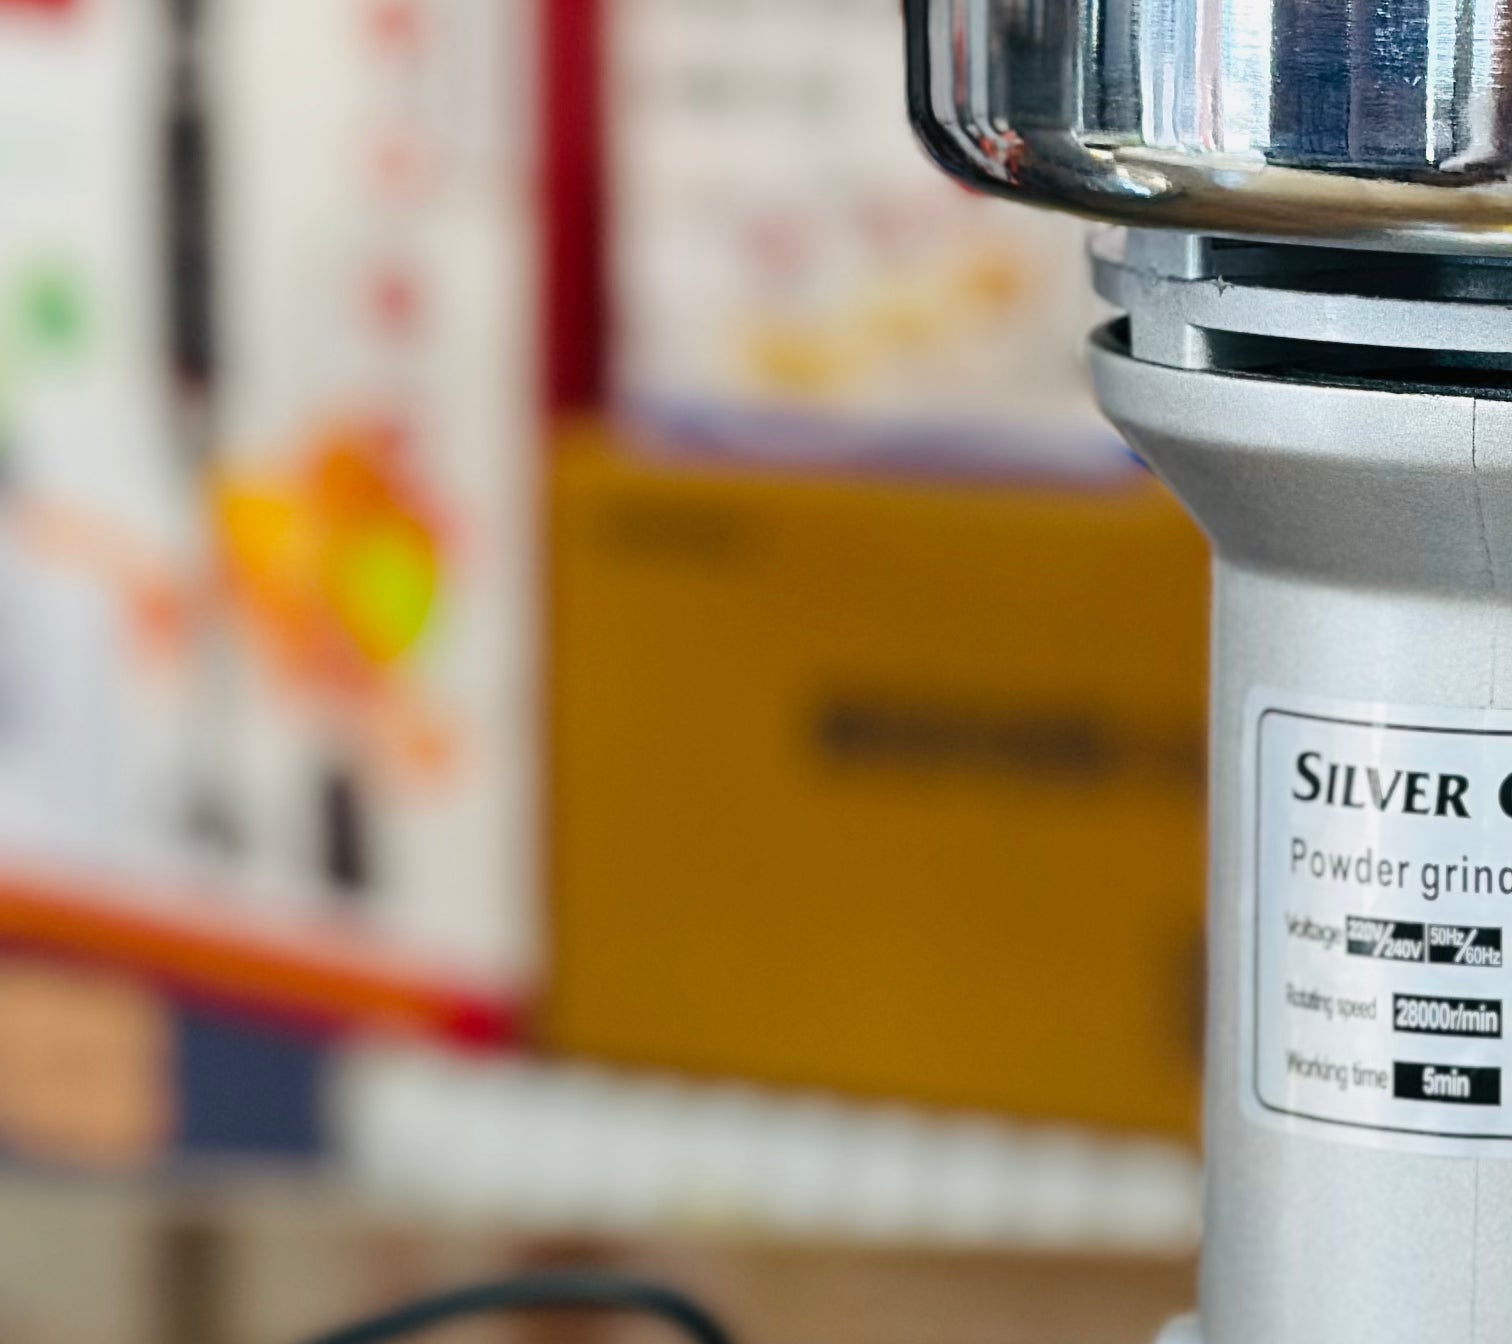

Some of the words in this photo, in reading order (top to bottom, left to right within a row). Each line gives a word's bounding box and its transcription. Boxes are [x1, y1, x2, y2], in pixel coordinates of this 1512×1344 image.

[1292, 751, 1471, 819] SILVER
[1291, 836, 1410, 889] Powder
[1337, 996, 1377, 1023] speed
[1396, 998, 1499, 1033] 28000r/min
[1286, 1048, 1348, 1091] Working
[1352, 1061, 1388, 1089] time
[1422, 1066, 1470, 1097] 5min
